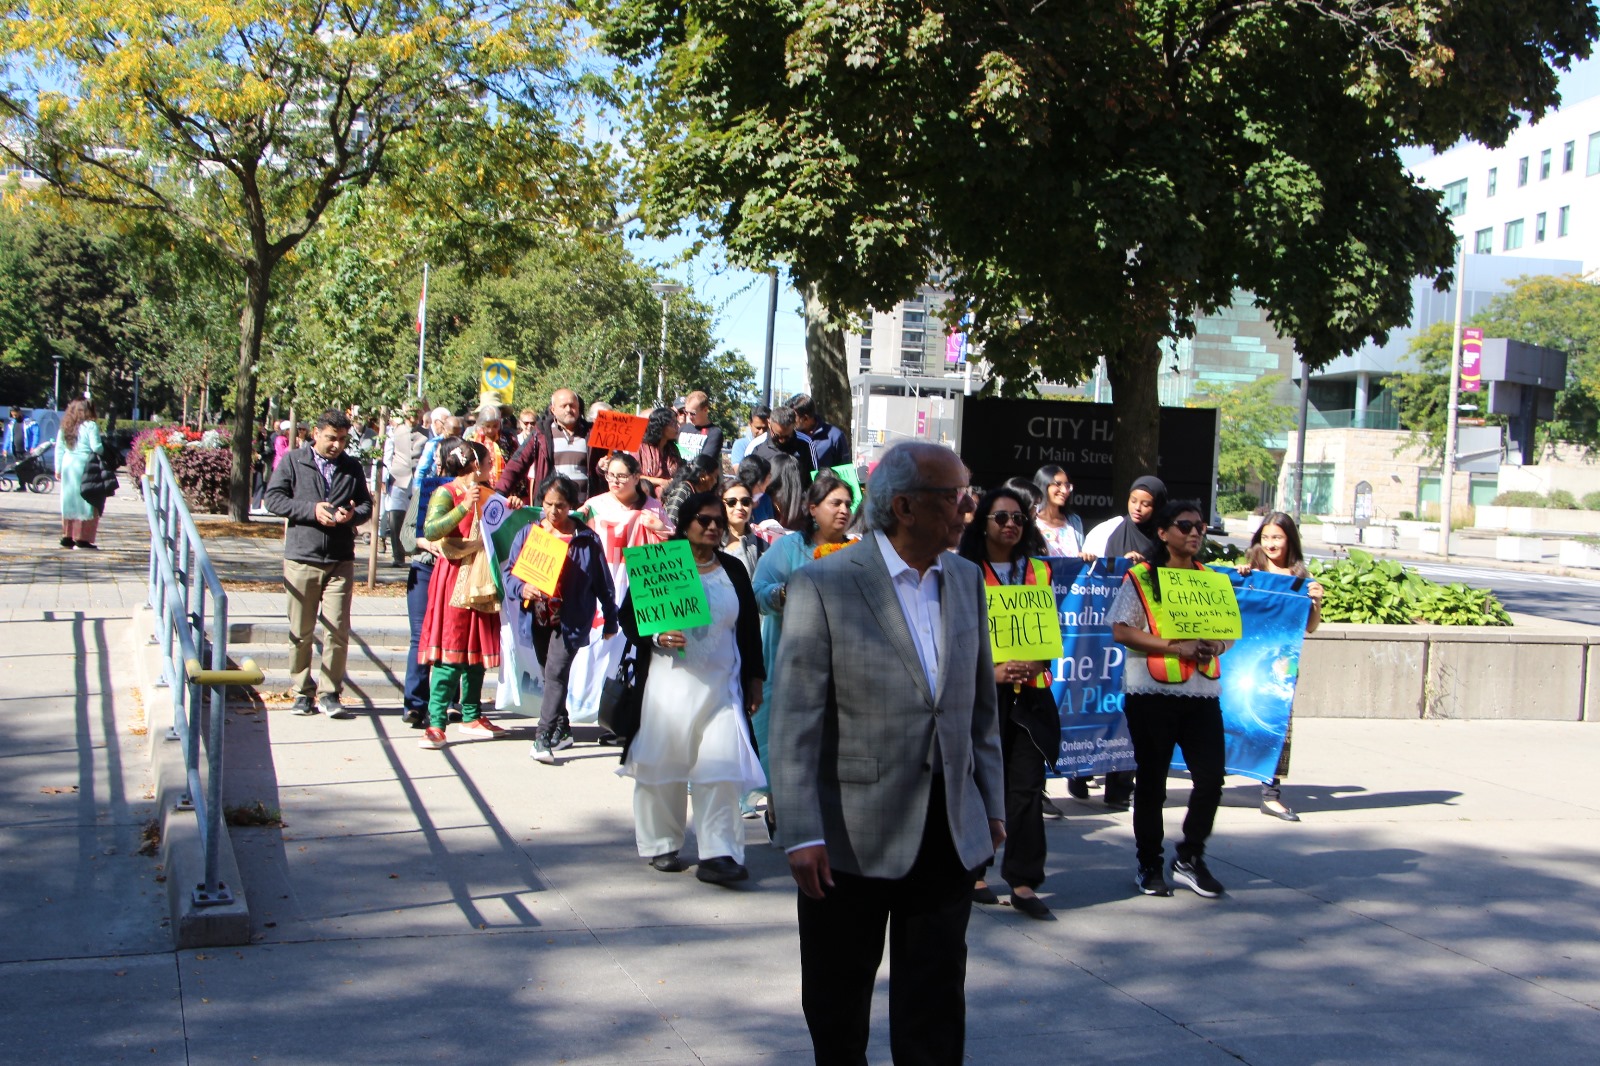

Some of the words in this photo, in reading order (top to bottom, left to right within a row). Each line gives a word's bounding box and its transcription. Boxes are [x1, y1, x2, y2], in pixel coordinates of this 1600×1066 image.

[597, 421, 633, 435] PEACE
[1027, 416, 1084, 440] CITY
[594, 432, 632, 450] NOW
[1013, 445, 1031, 460] 71
[1039, 446, 1075, 462] Main
[1081, 448, 1114, 464] Stree
[643, 544, 667, 560] I'M
[520, 545, 557, 579] CHEAPER
[630, 557, 683, 578] ALREADY
[643, 569, 695, 589] AGAINST
[1187, 574, 1211, 588] the
[649, 586, 670, 598] THE
[1070, 582, 1111, 598] Society
[1167, 589, 1230, 606] CHANGE
[999, 589, 1053, 611] WORLD
[636, 603, 666, 625] NEXT
[670, 596, 701, 618] WAR
[1168, 610, 1189, 621] you
[1195, 609, 1222, 618] wish
[1058, 688, 1075, 715] A
[1061, 739, 1095, 752] Ontario,
[1096, 736, 1129, 748] Canada
